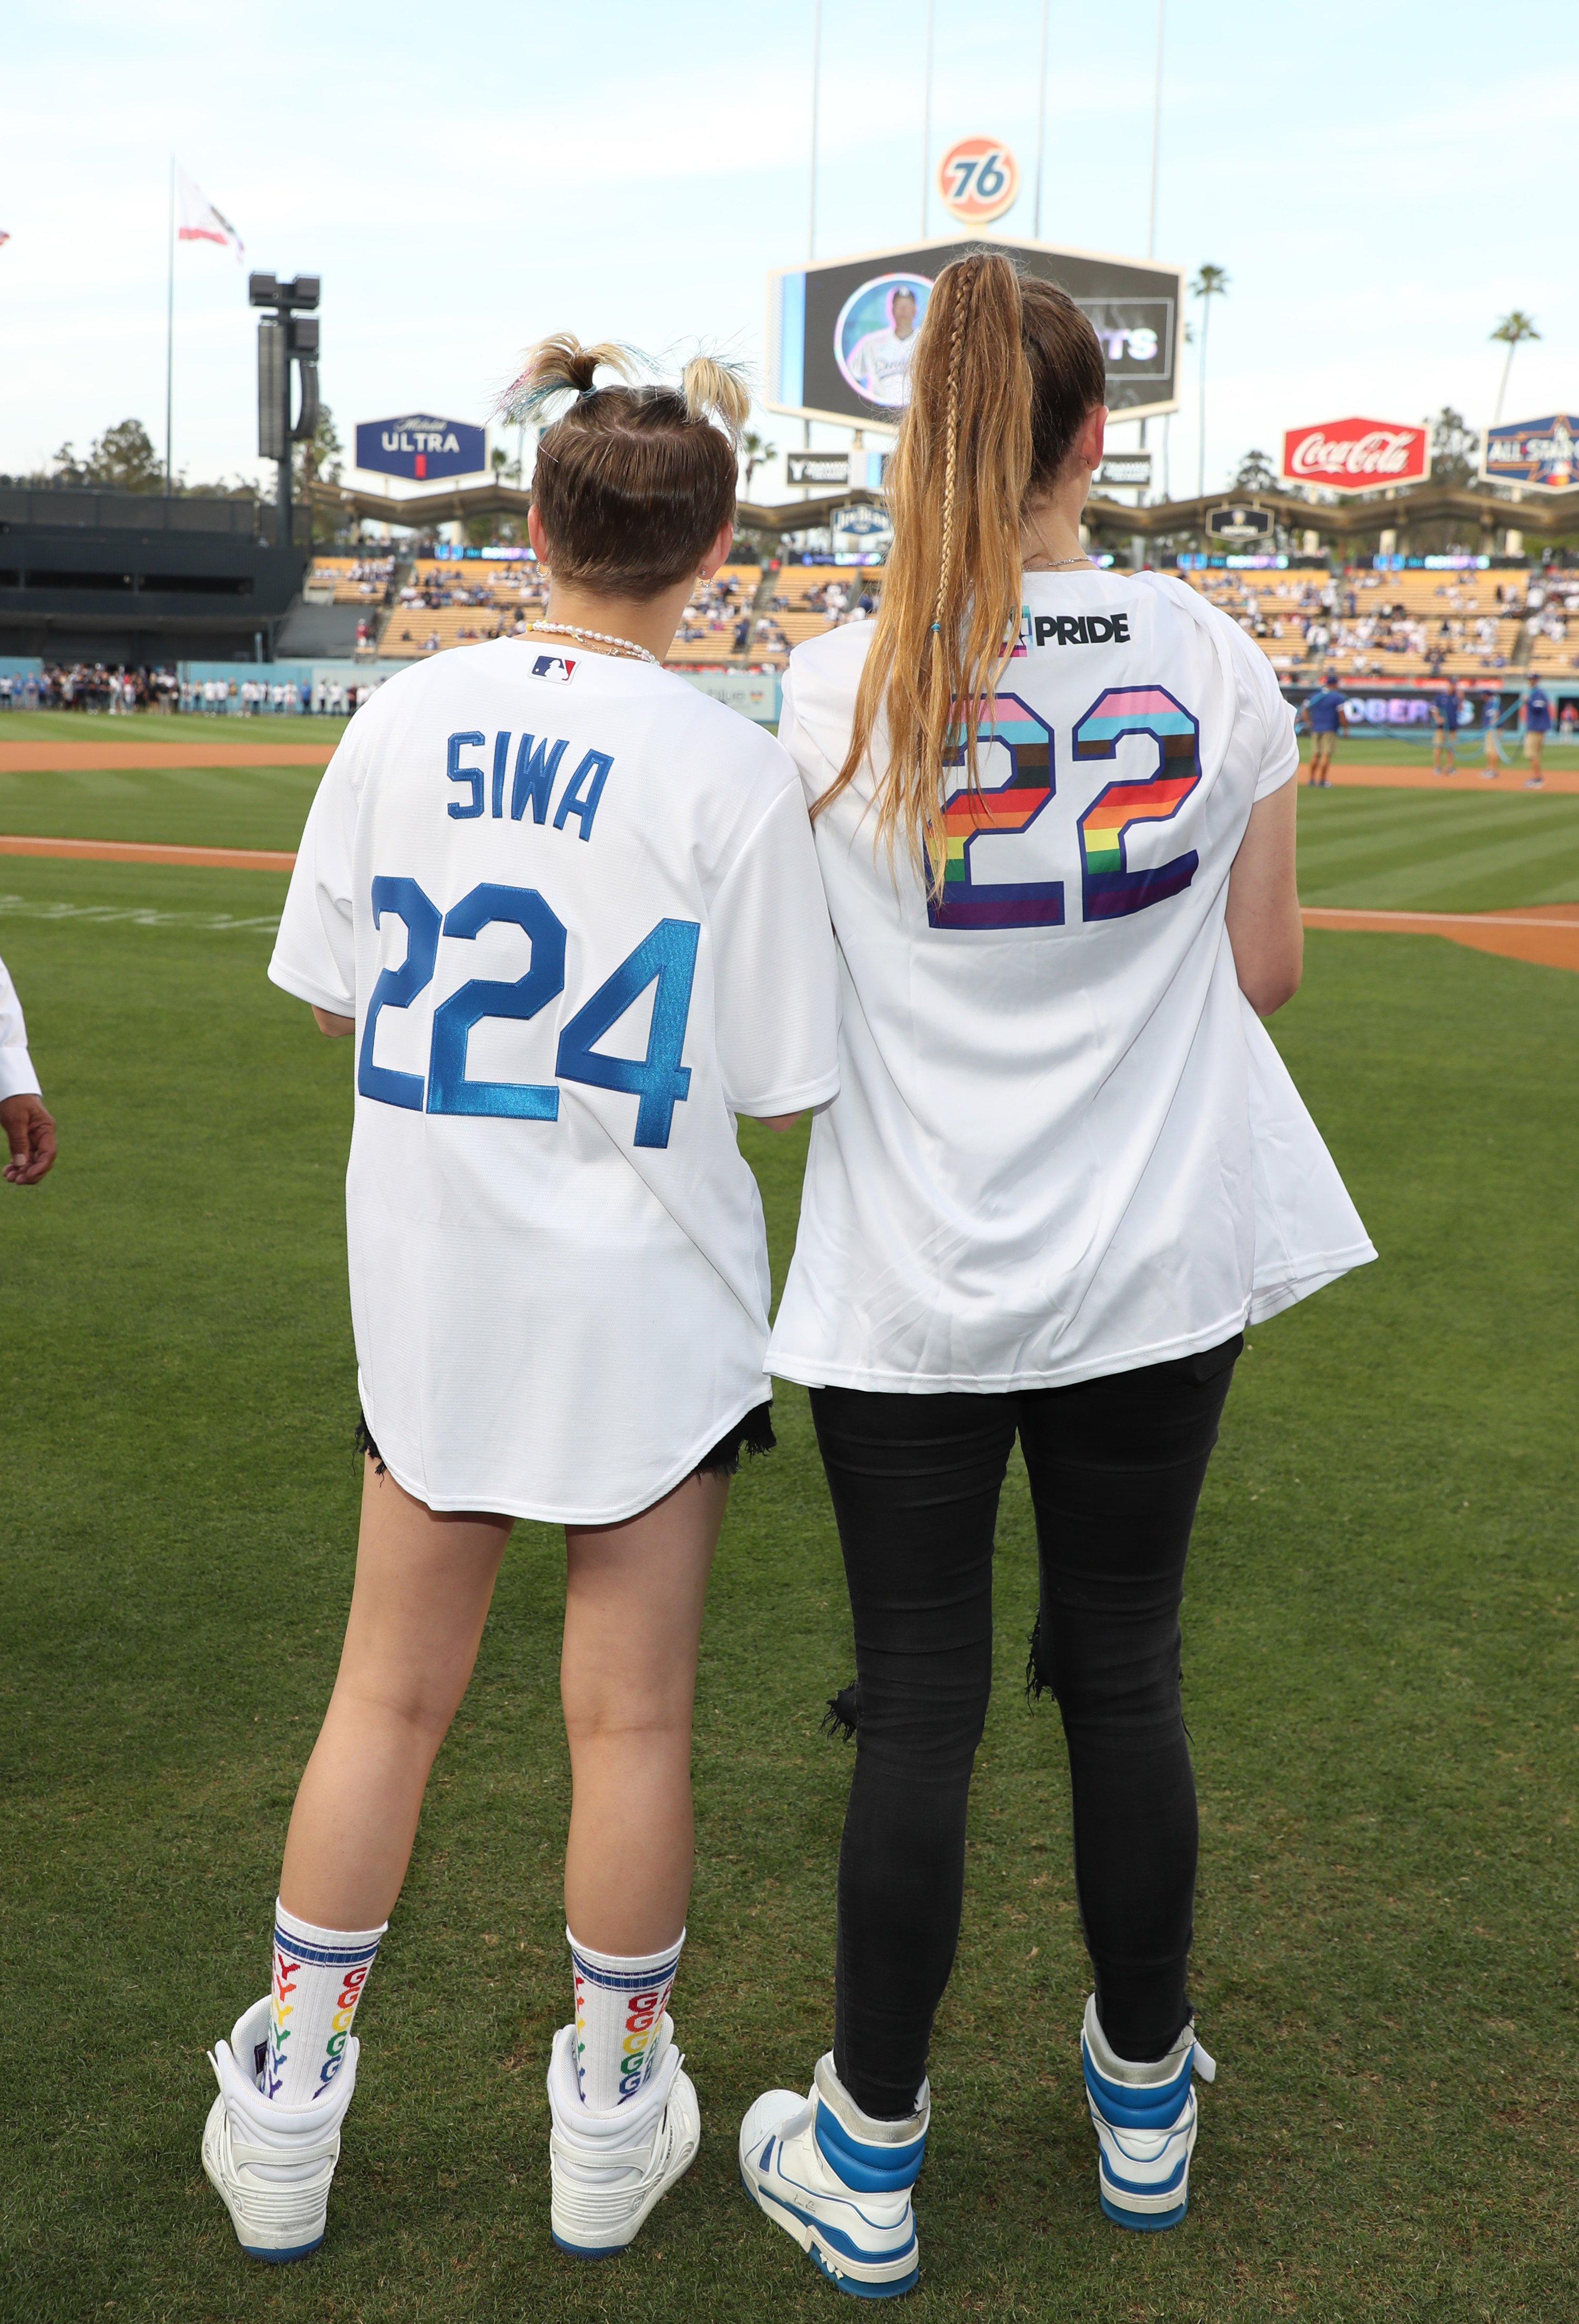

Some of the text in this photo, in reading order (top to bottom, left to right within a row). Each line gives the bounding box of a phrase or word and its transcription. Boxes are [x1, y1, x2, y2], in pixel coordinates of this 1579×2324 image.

[953, 154, 1005, 197] 76
[382, 431, 461, 453] ULTRA
[1034, 613, 1131, 646] PRIDE
[447, 731, 615, 842] SIWA
[922, 684, 1203, 930] 22
[358, 875, 701, 1149] 224
